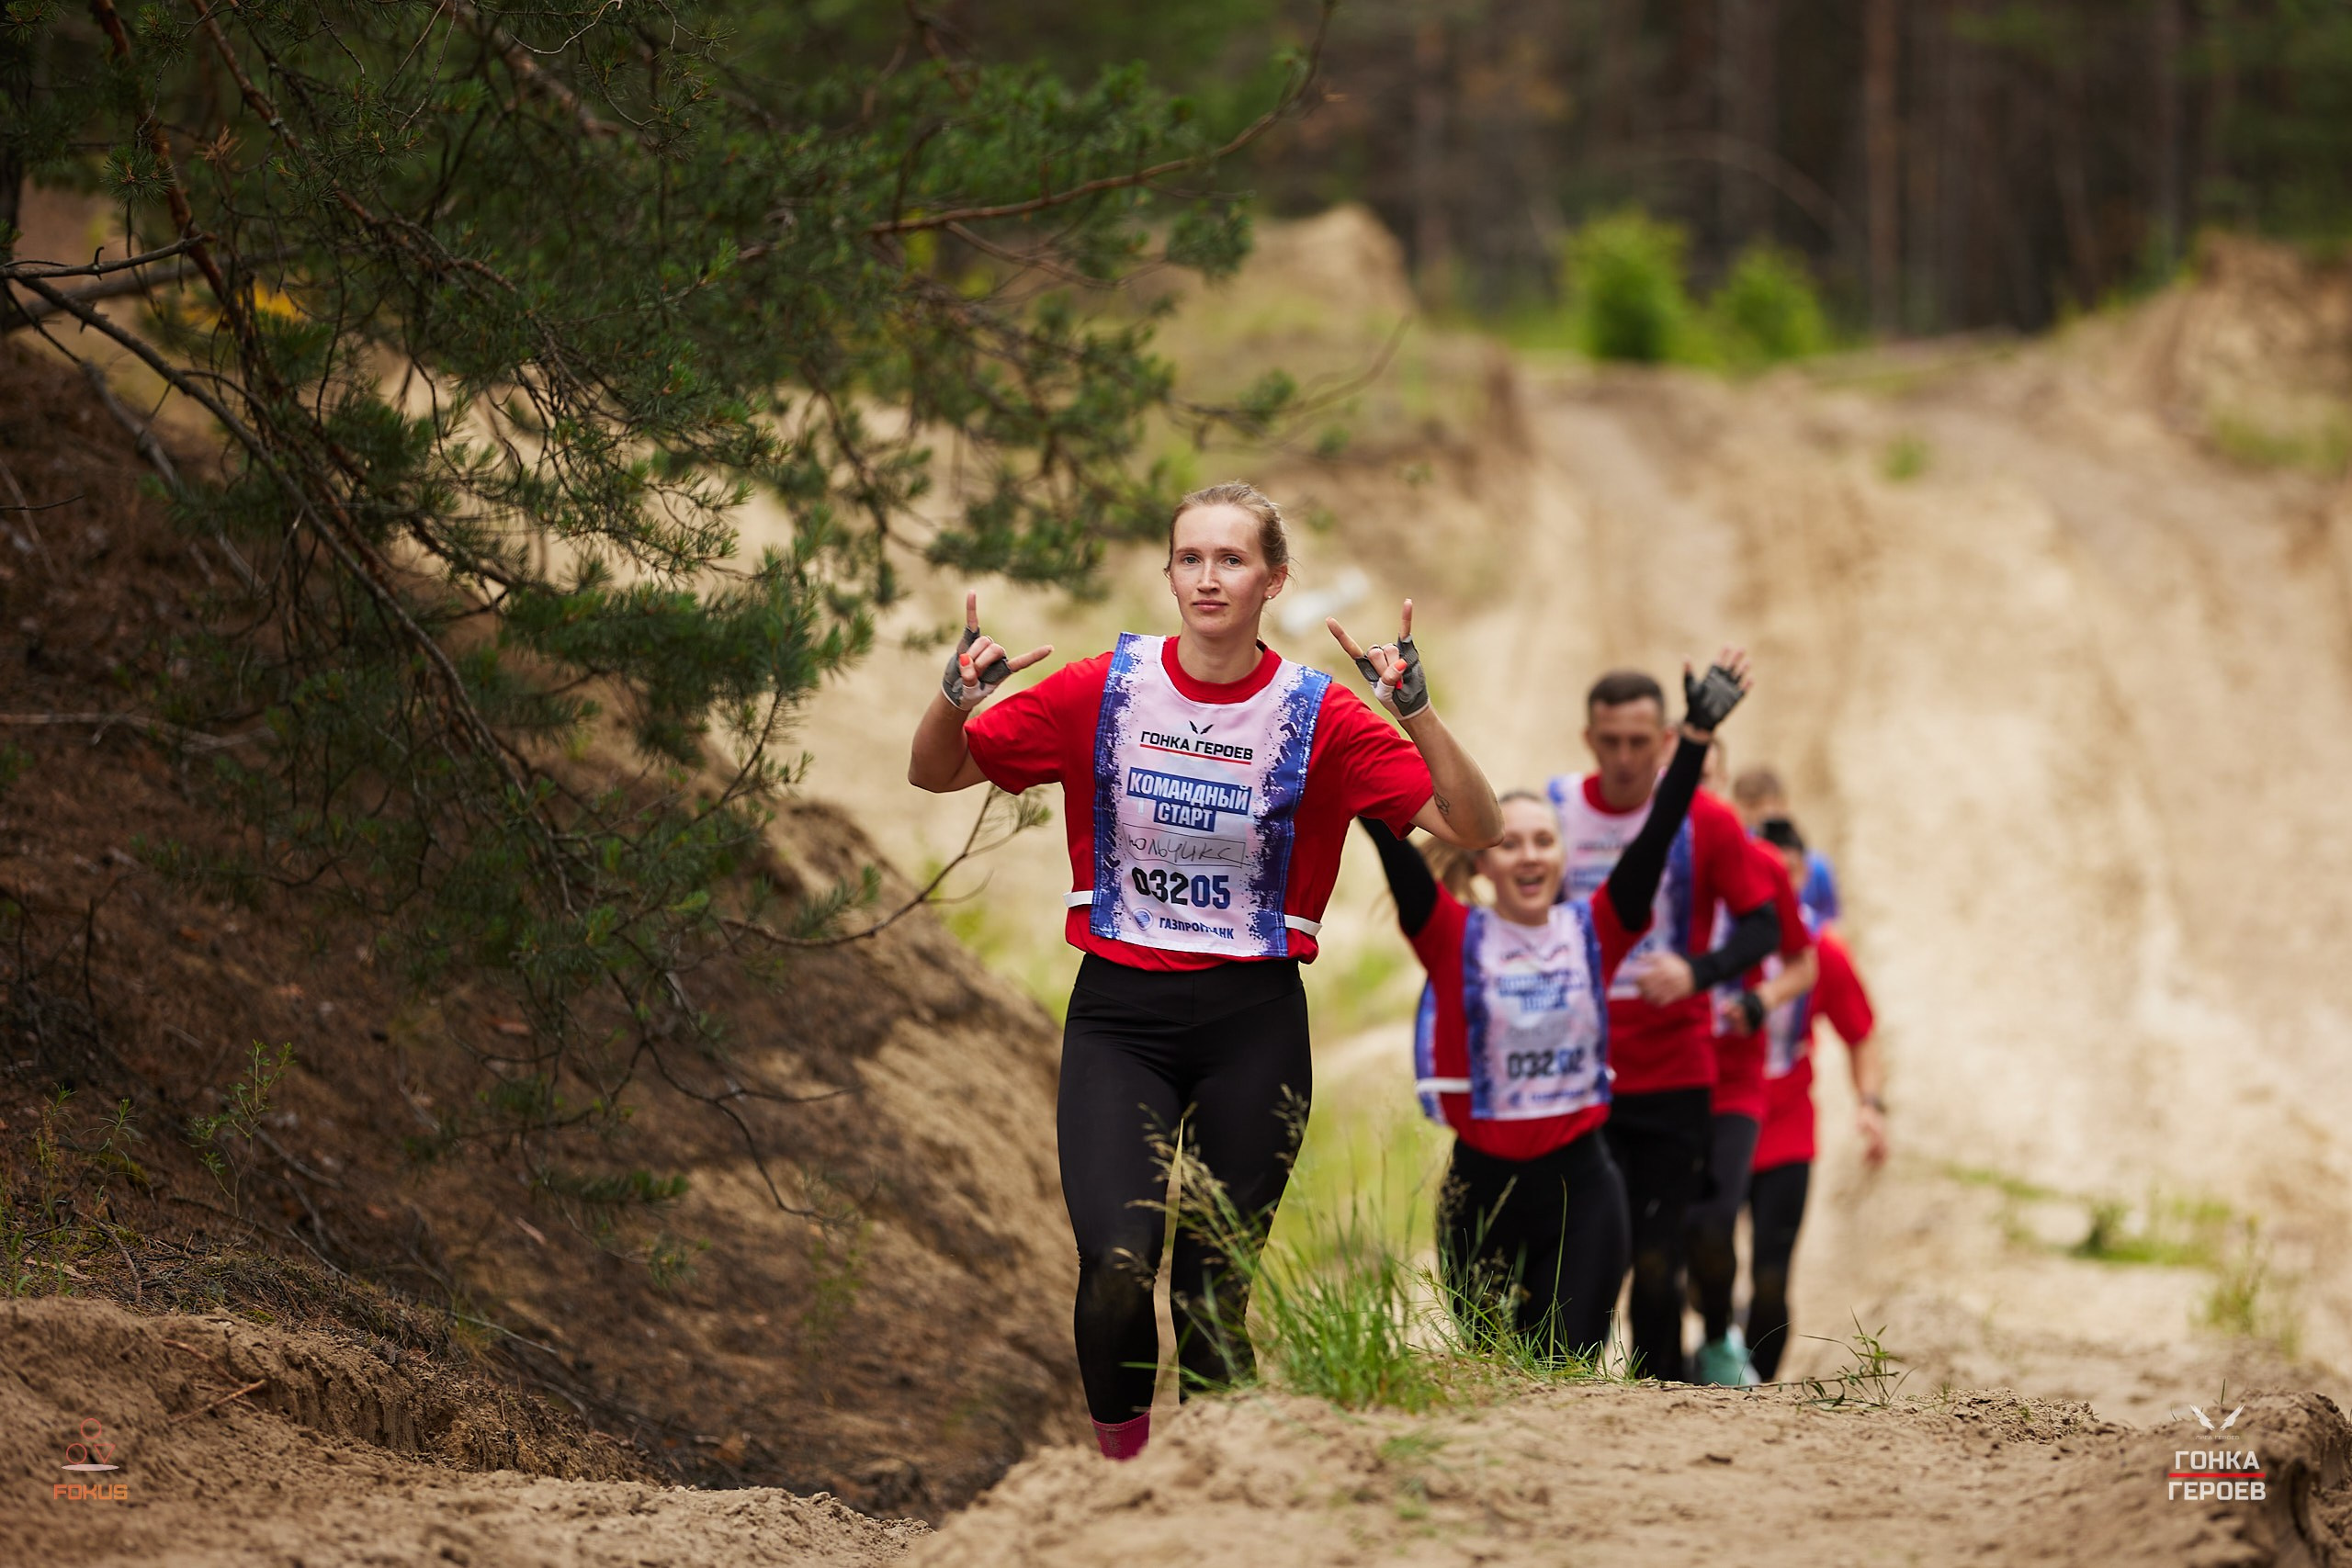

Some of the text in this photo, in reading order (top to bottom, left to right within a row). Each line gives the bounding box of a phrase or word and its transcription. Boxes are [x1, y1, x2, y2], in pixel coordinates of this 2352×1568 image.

[1140, 730, 1253, 761] ГОНКА ГЕРОЕВ
[1129, 772, 1250, 811] КОМАНДНЫЙ
[1158, 802, 1214, 829] СТАРТ
[1132, 867, 1231, 909] 03205
